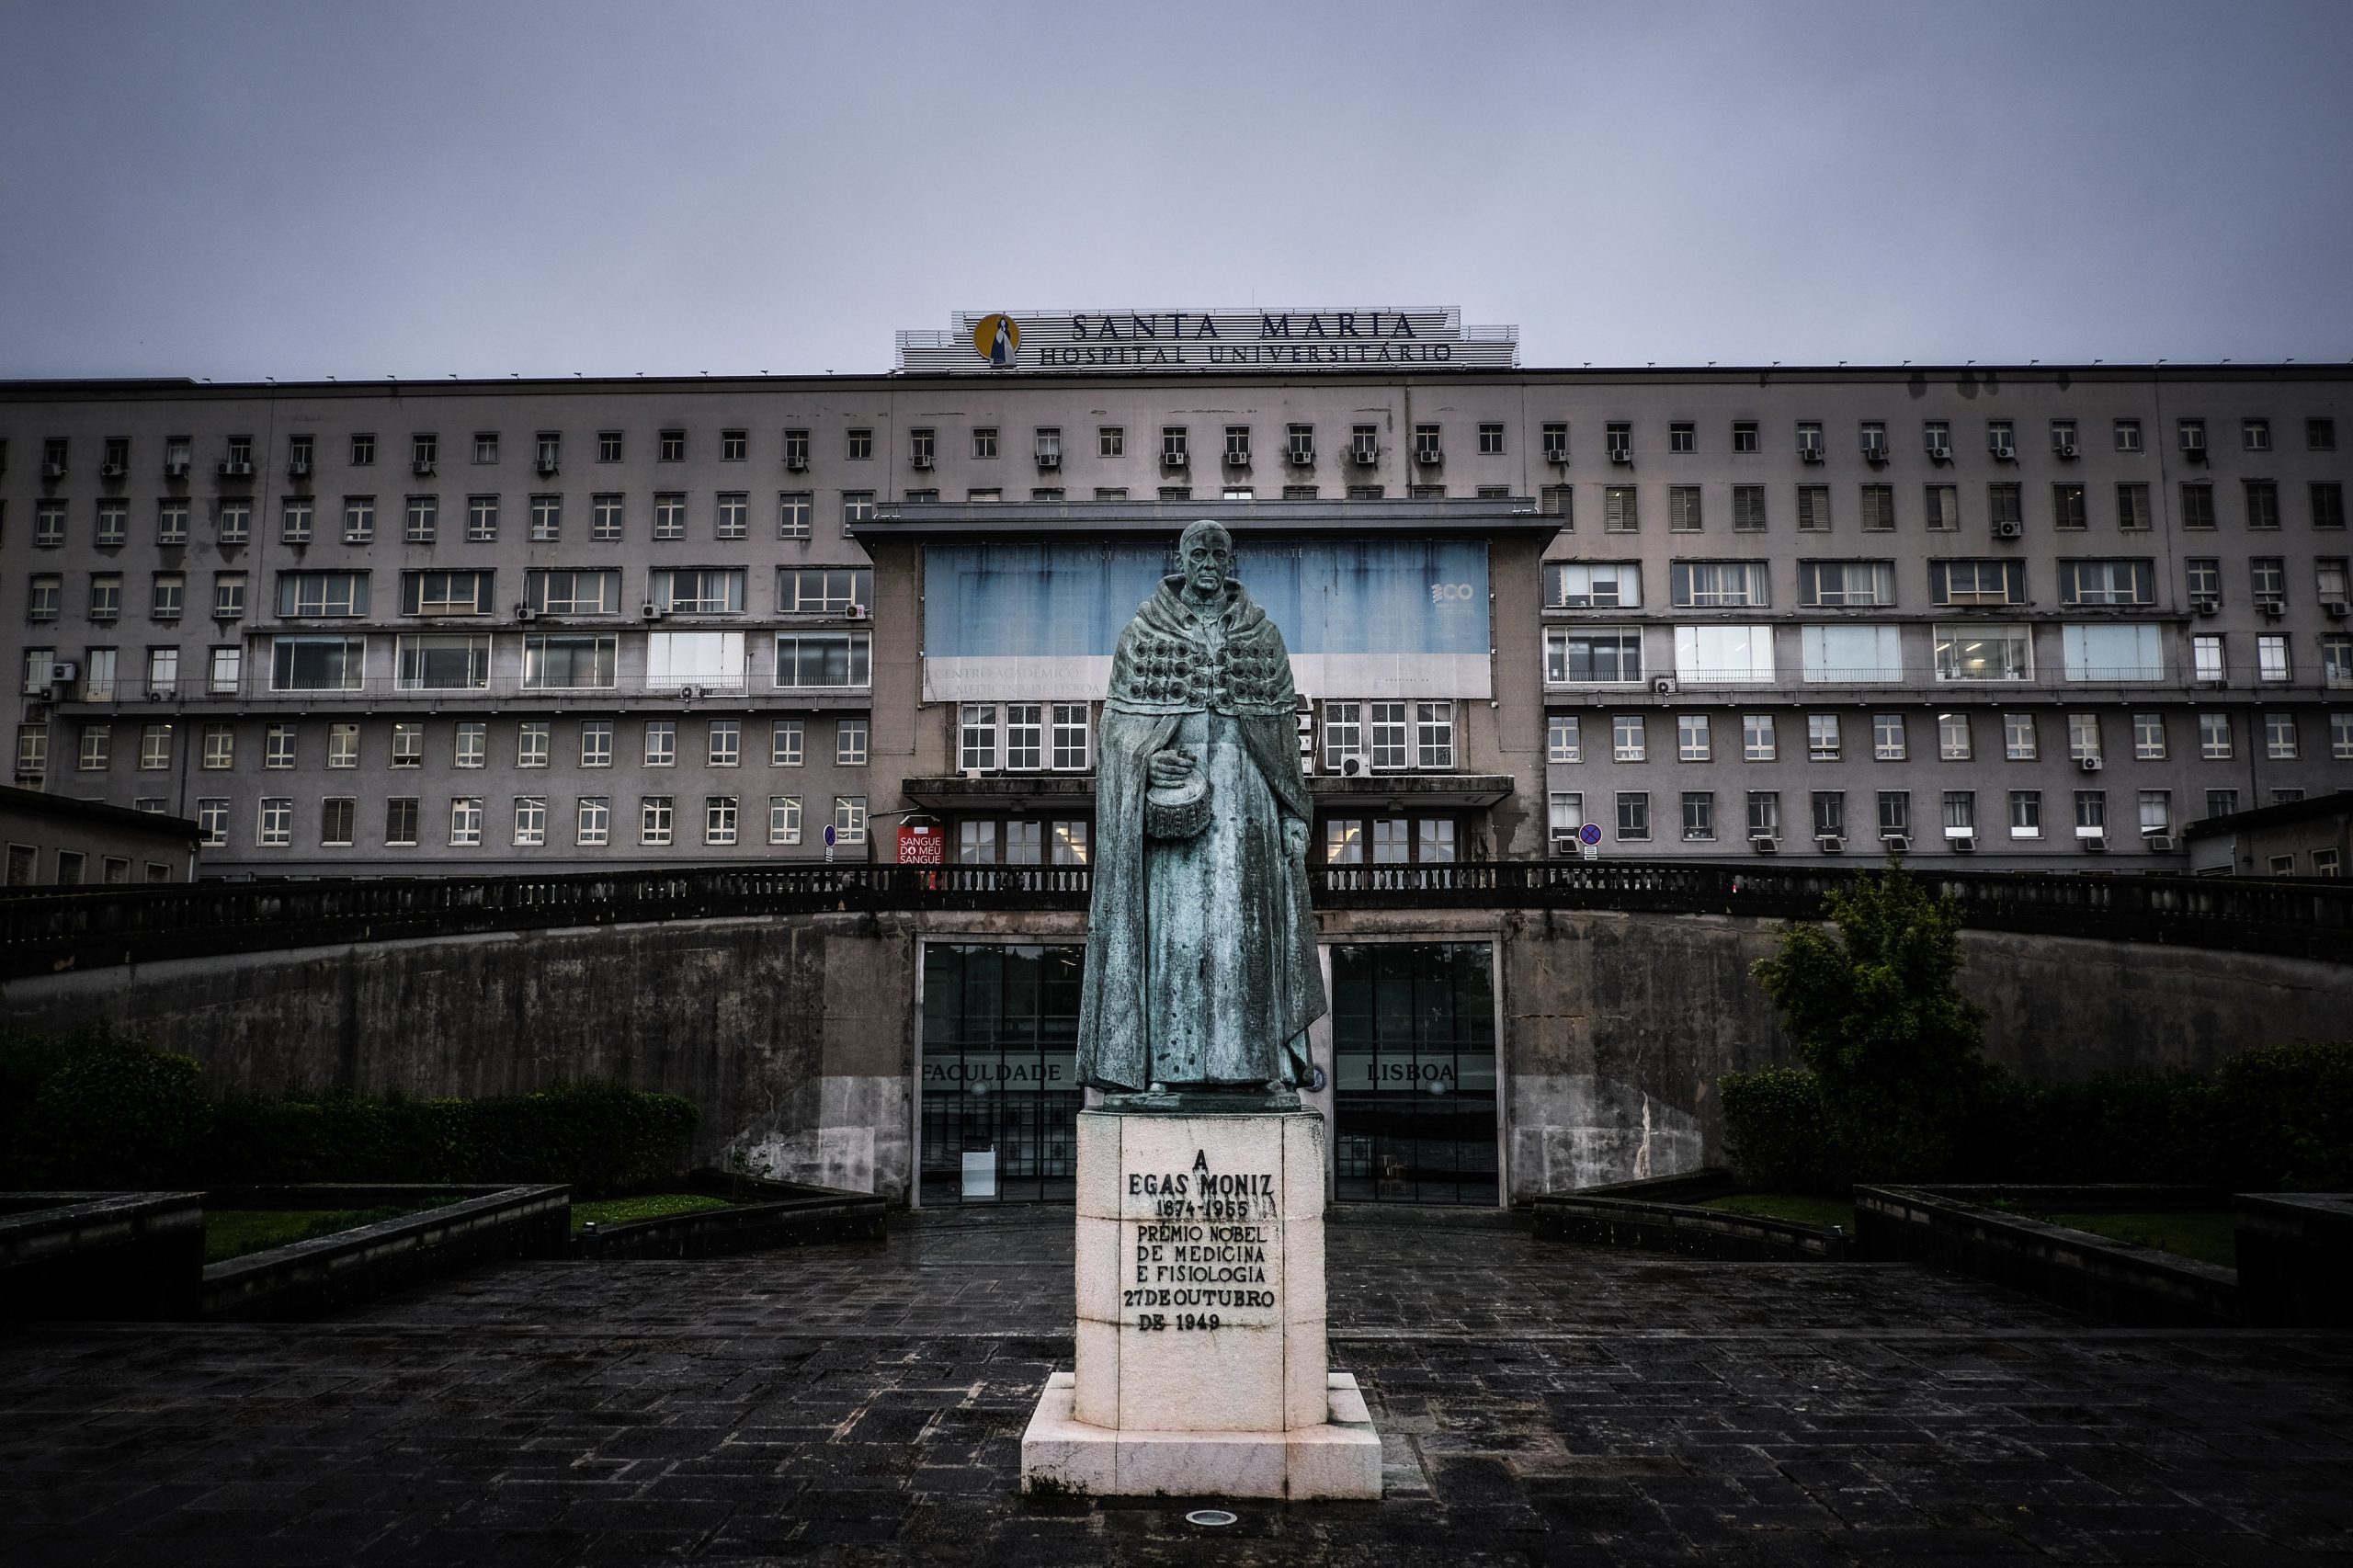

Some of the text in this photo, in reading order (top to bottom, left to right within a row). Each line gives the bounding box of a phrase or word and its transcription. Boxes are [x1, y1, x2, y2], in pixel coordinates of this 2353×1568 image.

[1072, 312, 1416, 340] SANTA MARIA
[1040, 341, 1451, 365] HOSPITAL UNIVERSITÁRIO
[901, 837, 941, 846] SANGUE
[901, 846, 941, 855] DO MEU
[901, 855, 941, 864] SANGUE
[922, 1063, 1062, 1081] FACULDADE
[1367, 1063, 1455, 1081] LISBOA
[1193, 1149, 1208, 1171] A
[1129, 1174, 1275, 1196] EGAS MONIZ
[1211, 1226, 1267, 1243] NOBEL
[1138, 1245, 1265, 1263] DE MEDICINA
[1137, 1265, 1266, 1282] E FISIOLOGIA
[1139, 1313, 1220, 1331] DE 1949
